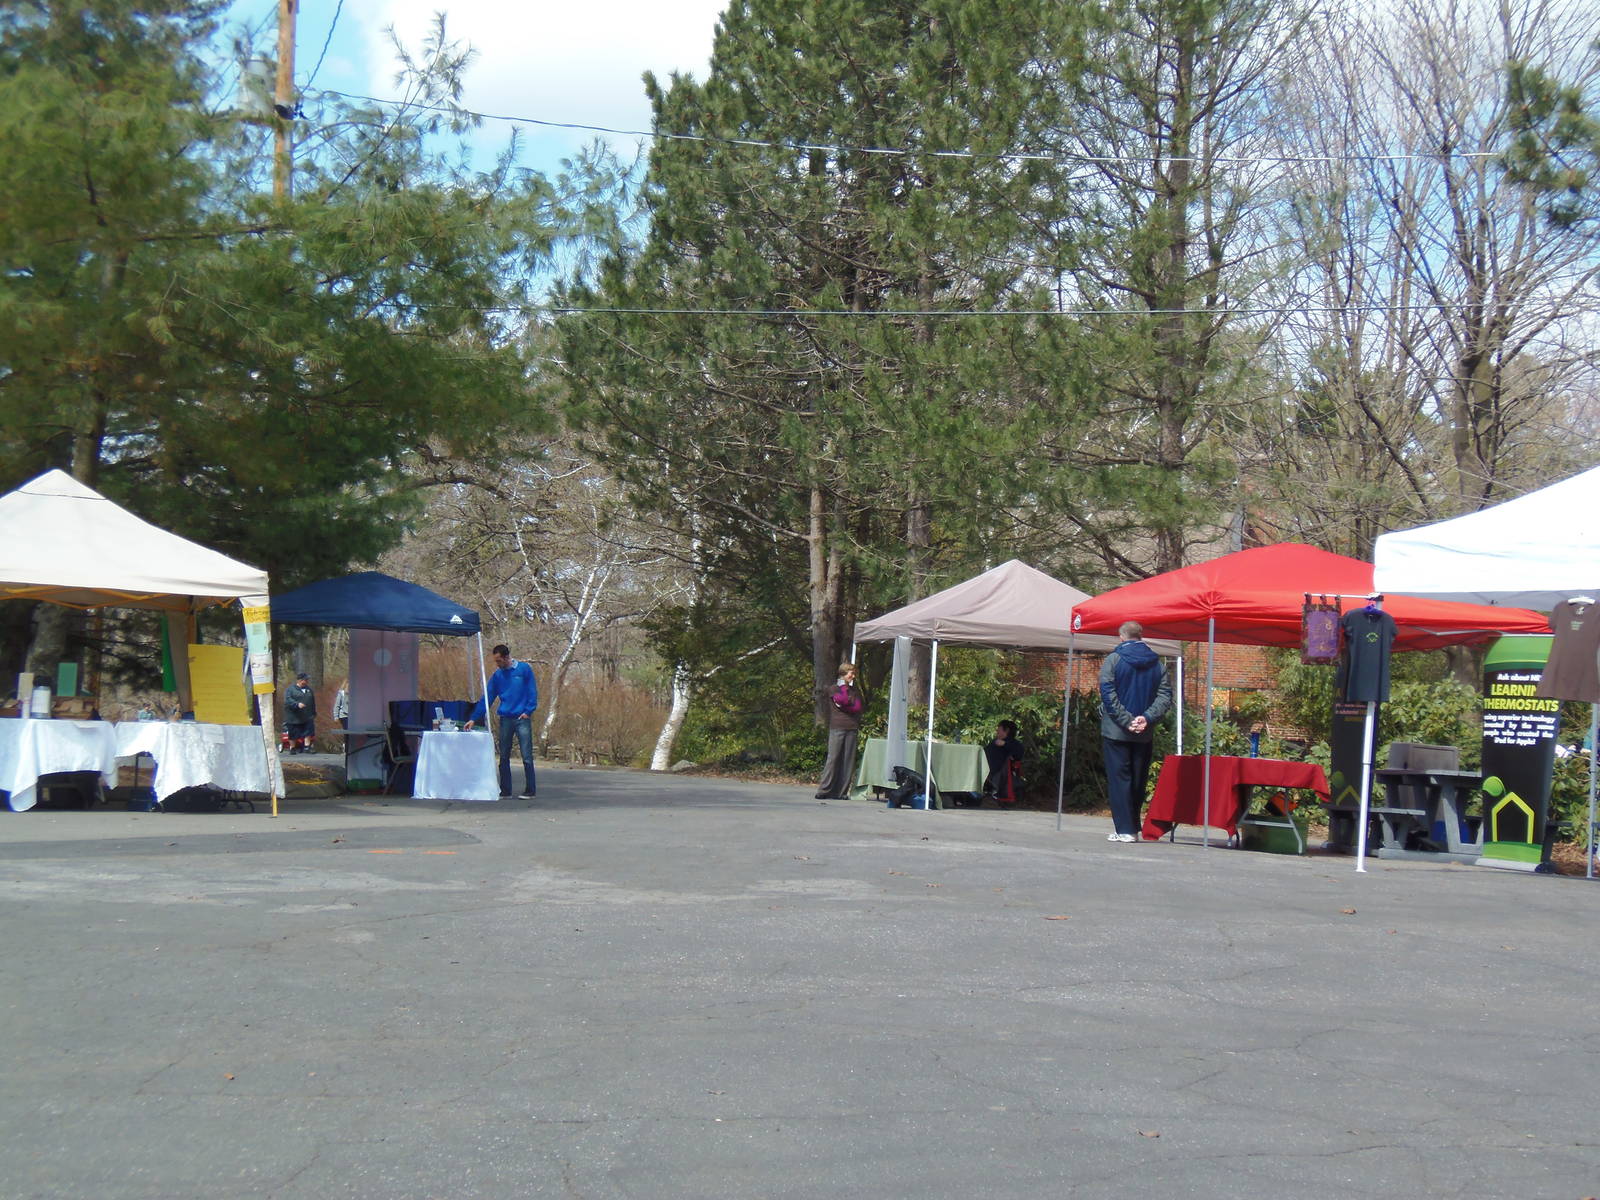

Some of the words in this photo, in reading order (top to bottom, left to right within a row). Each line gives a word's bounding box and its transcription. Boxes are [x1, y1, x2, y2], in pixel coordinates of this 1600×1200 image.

[1491, 684, 1537, 696] LEARNIN
[1484, 698, 1559, 711] THERMOSTATS
[1522, 714, 1556, 723] technology
[1509, 722, 1517, 730] by
